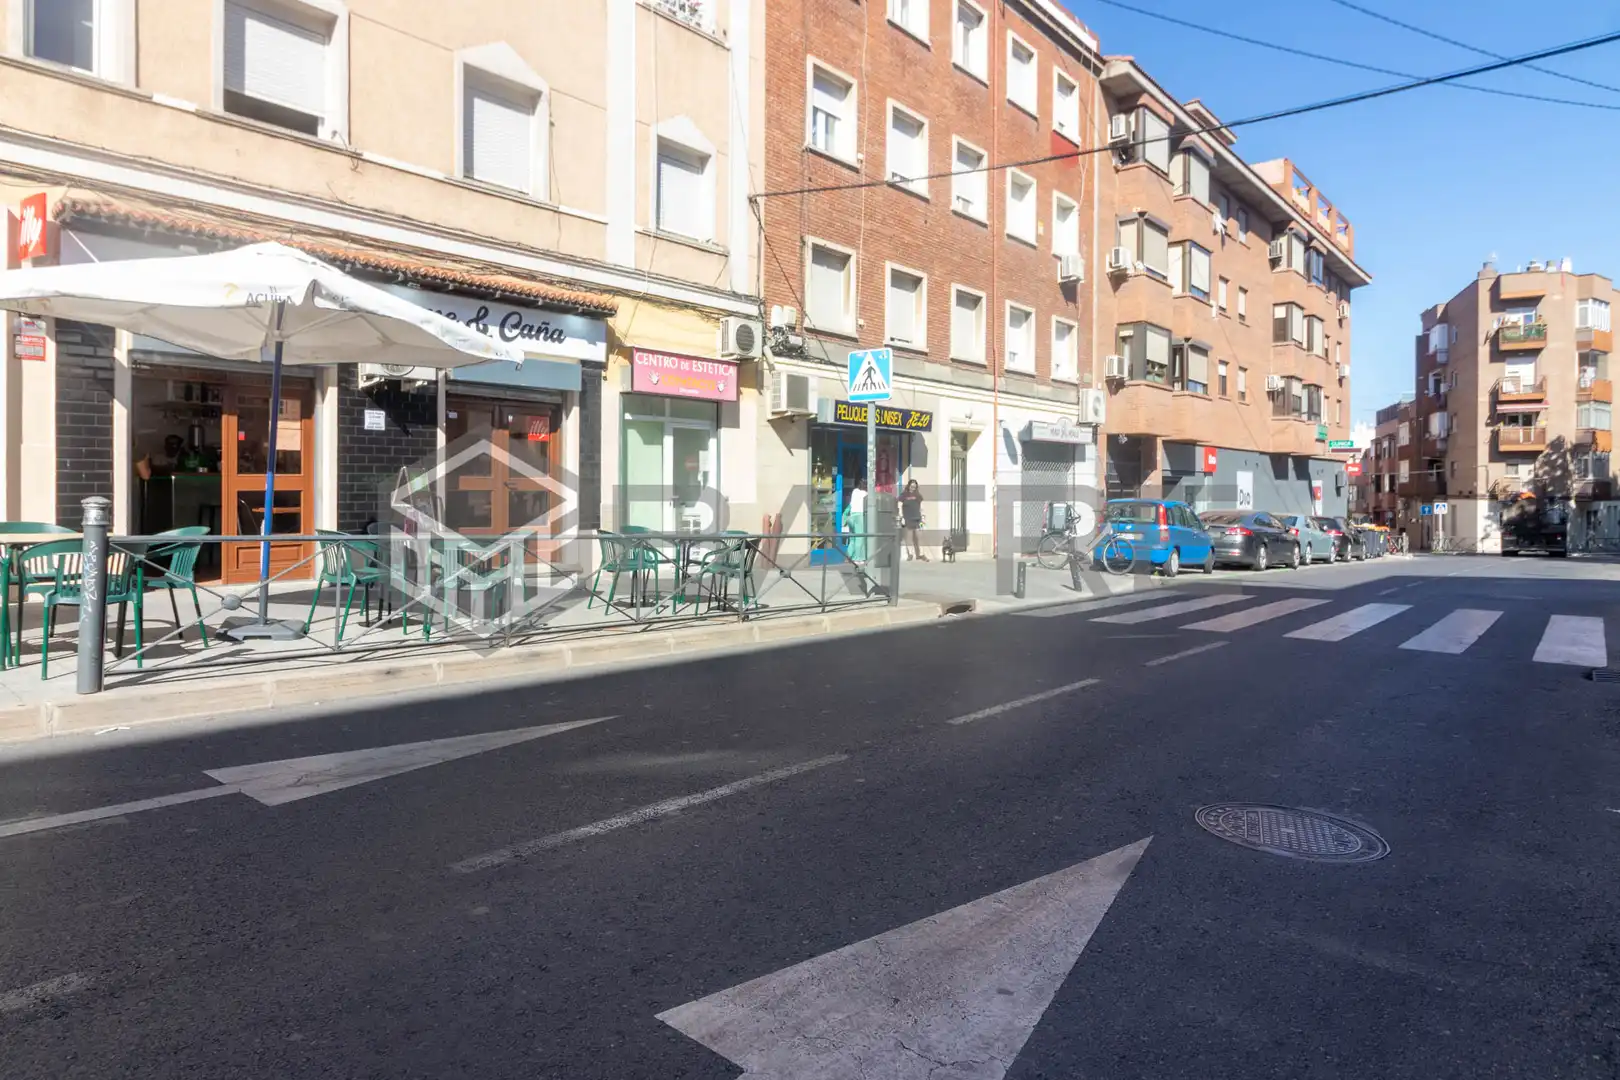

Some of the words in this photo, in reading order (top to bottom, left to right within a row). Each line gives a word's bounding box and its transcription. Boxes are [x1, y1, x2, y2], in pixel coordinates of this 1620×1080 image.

[20, 205, 43, 252] illy
[499, 311, 566, 344] Caña
[635, 352, 678, 369] CENTRO
[692, 360, 735, 377] ESTETICA
[529, 420, 549, 439] illy
[881, 409, 903, 426] UNISEX
